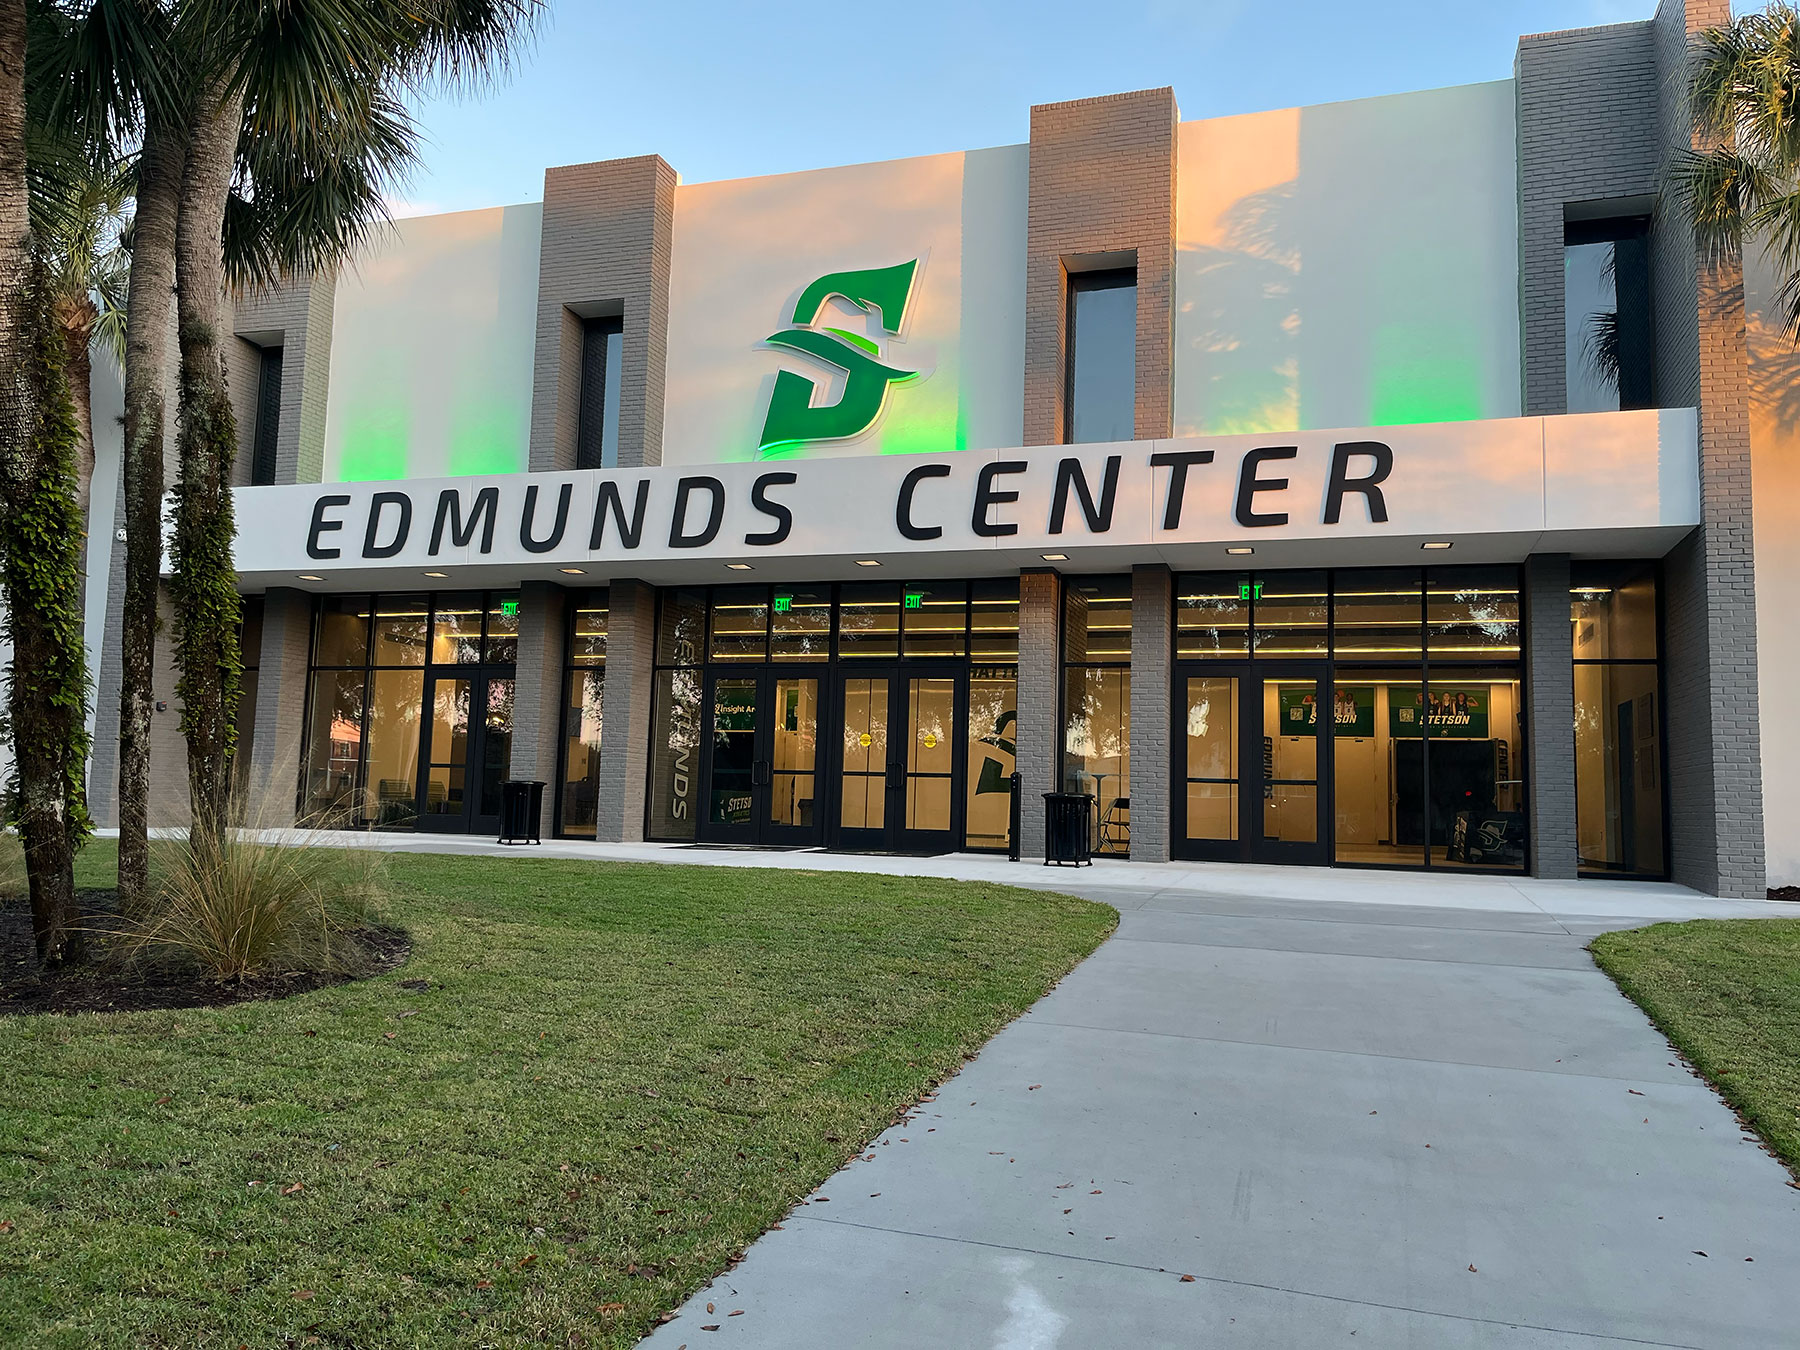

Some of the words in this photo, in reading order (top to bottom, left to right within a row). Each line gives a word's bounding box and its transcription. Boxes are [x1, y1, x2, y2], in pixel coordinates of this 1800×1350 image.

[305, 472, 798, 560] EDMUNDS
[897, 440, 1394, 541] CENTER
[1241, 584, 1260, 600] ET
[775, 598, 790, 611] EXIT
[905, 595, 921, 608] EXIT
[1308, 714, 1358, 724] SSON
